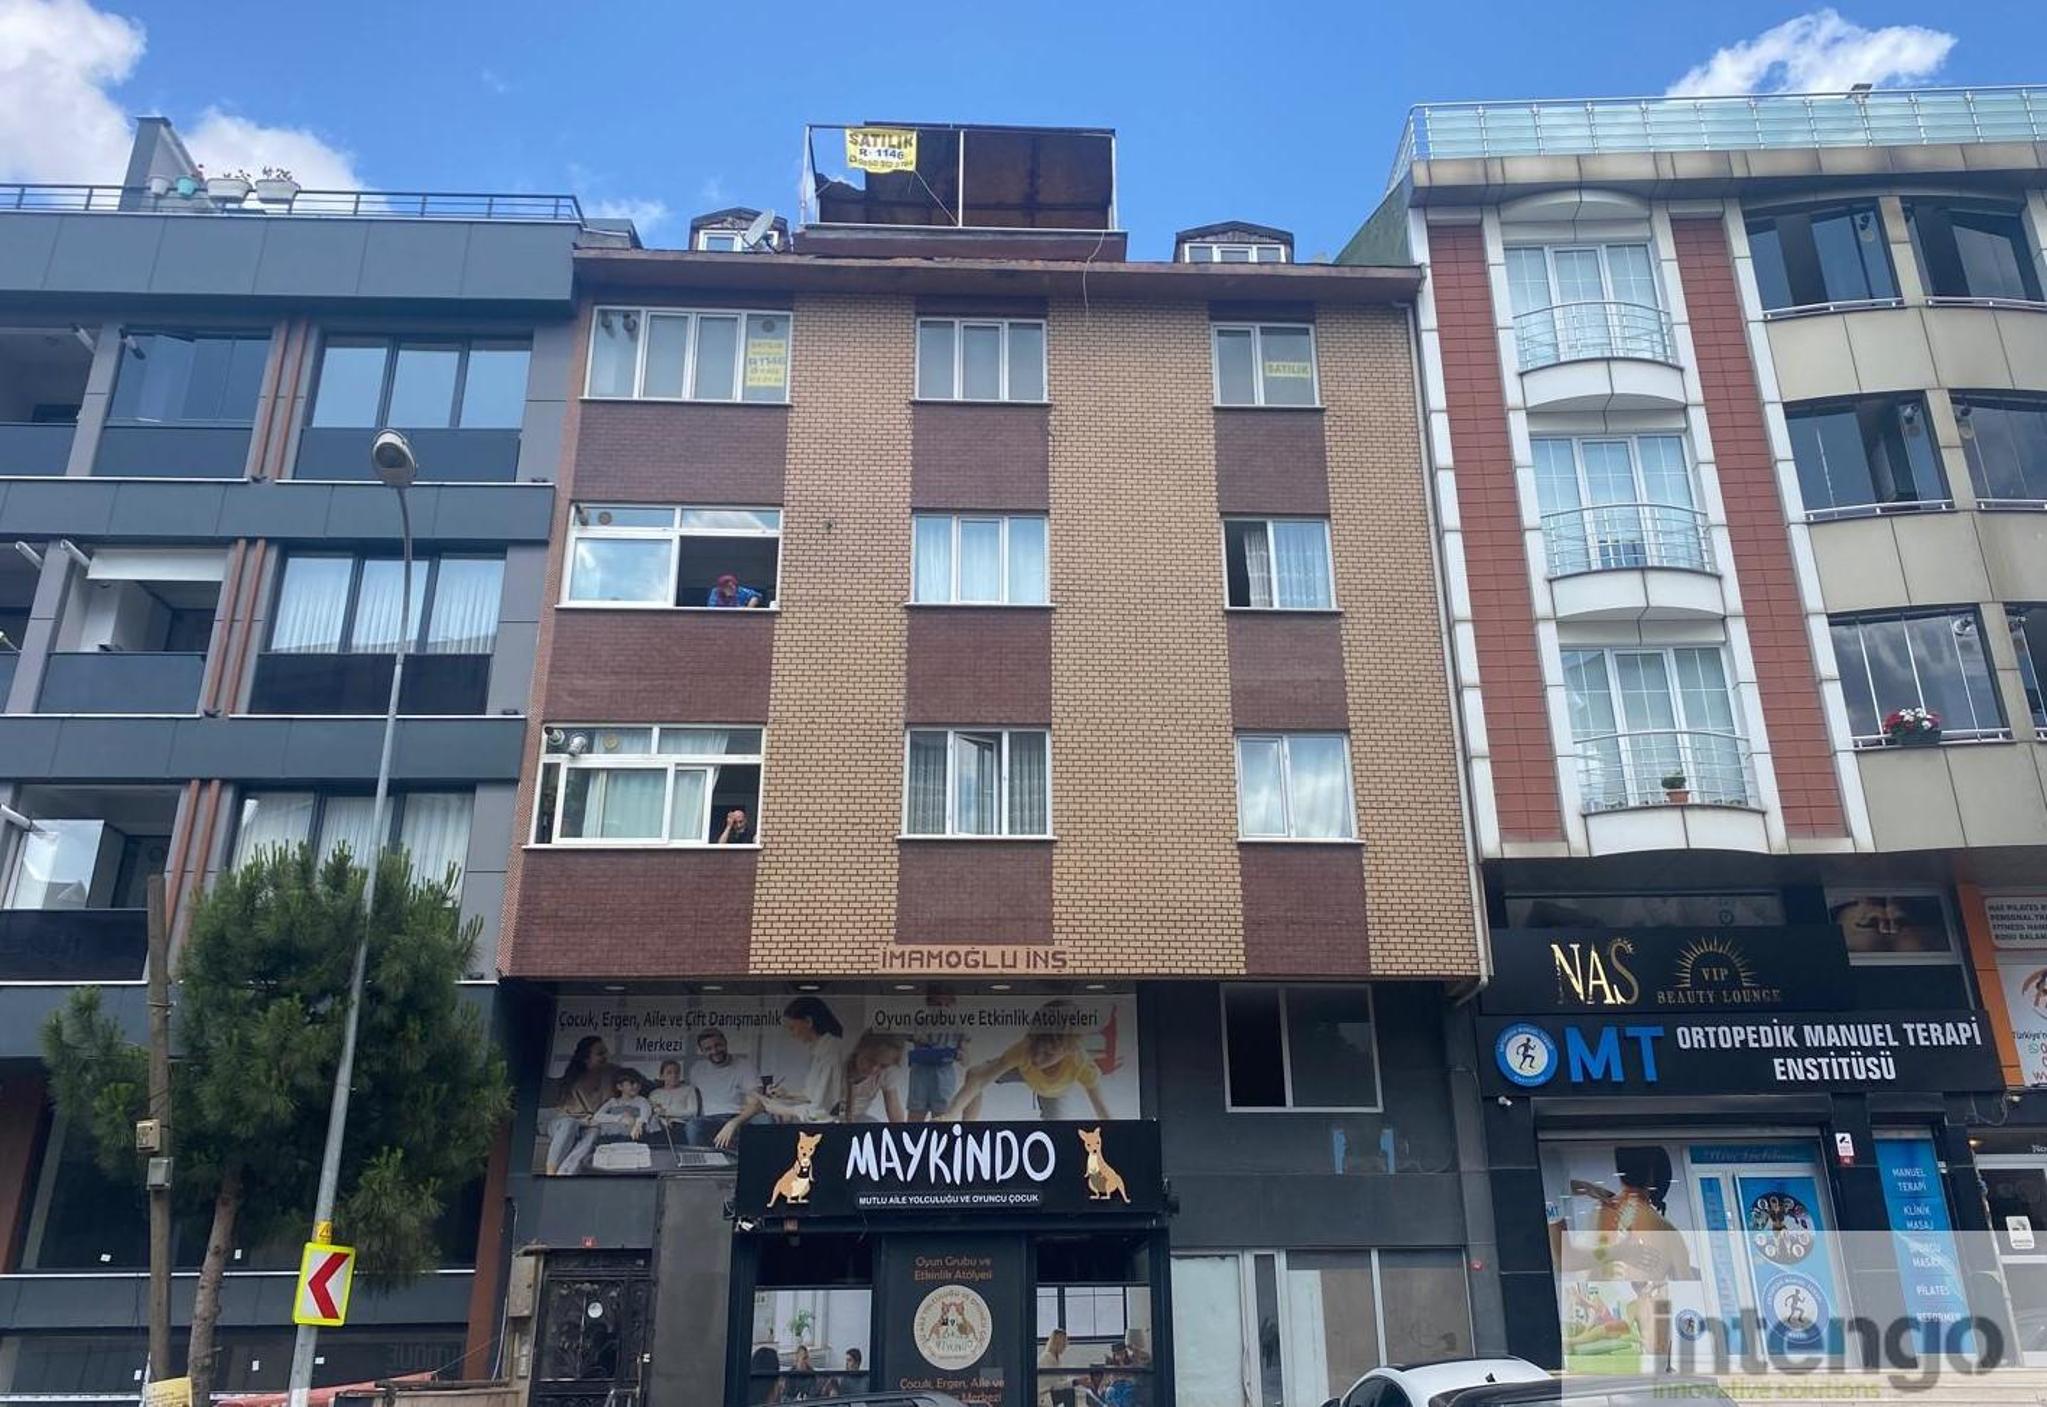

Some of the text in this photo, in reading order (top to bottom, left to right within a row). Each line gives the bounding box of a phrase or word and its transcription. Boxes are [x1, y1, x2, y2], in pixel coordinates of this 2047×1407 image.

[849, 133, 914, 149] SATILIK
[1550, 938, 1639, 1005] NAS
[1702, 967, 1729, 981] VIP
[1657, 988, 1781, 1004] BEAUTY LOUNGE
[558, 1008, 783, 1031] Çocuk, Ergen, Aile ve Çift Danışmanlık
[875, 1010, 912, 1031] Oyun
[914, 1009, 956, 1027] Grubu
[960, 1014, 975, 1026] ve
[979, 1009, 1030, 1027] Etkinlik
[1676, 1018, 1799, 1049] ORTOPEDİK
[1803, 1023, 1899, 1047] MANUEL
[1902, 1016, 1982, 1046] TERAPİ
[635, 1036, 683, 1052] Merkezi
[1773, 1051, 1897, 1081] ENSTİTÜSÜ
[1892, 1168, 1927, 1177] MANUEL
[859, 1196, 888, 1205] MUTLU
[908, 1193, 958, 1204] YOLCULUĞU
[960, 1195, 971, 1203] VE
[973, 1195, 1007, 1203] OYUNCU
[1009, 1194, 1039, 1204] ÇOCUK
[915, 1256, 992, 1268] Oyun Grubu ve
[970, 1377, 990, 1388] Aile
[991, 1379, 1005, 1388] ve
